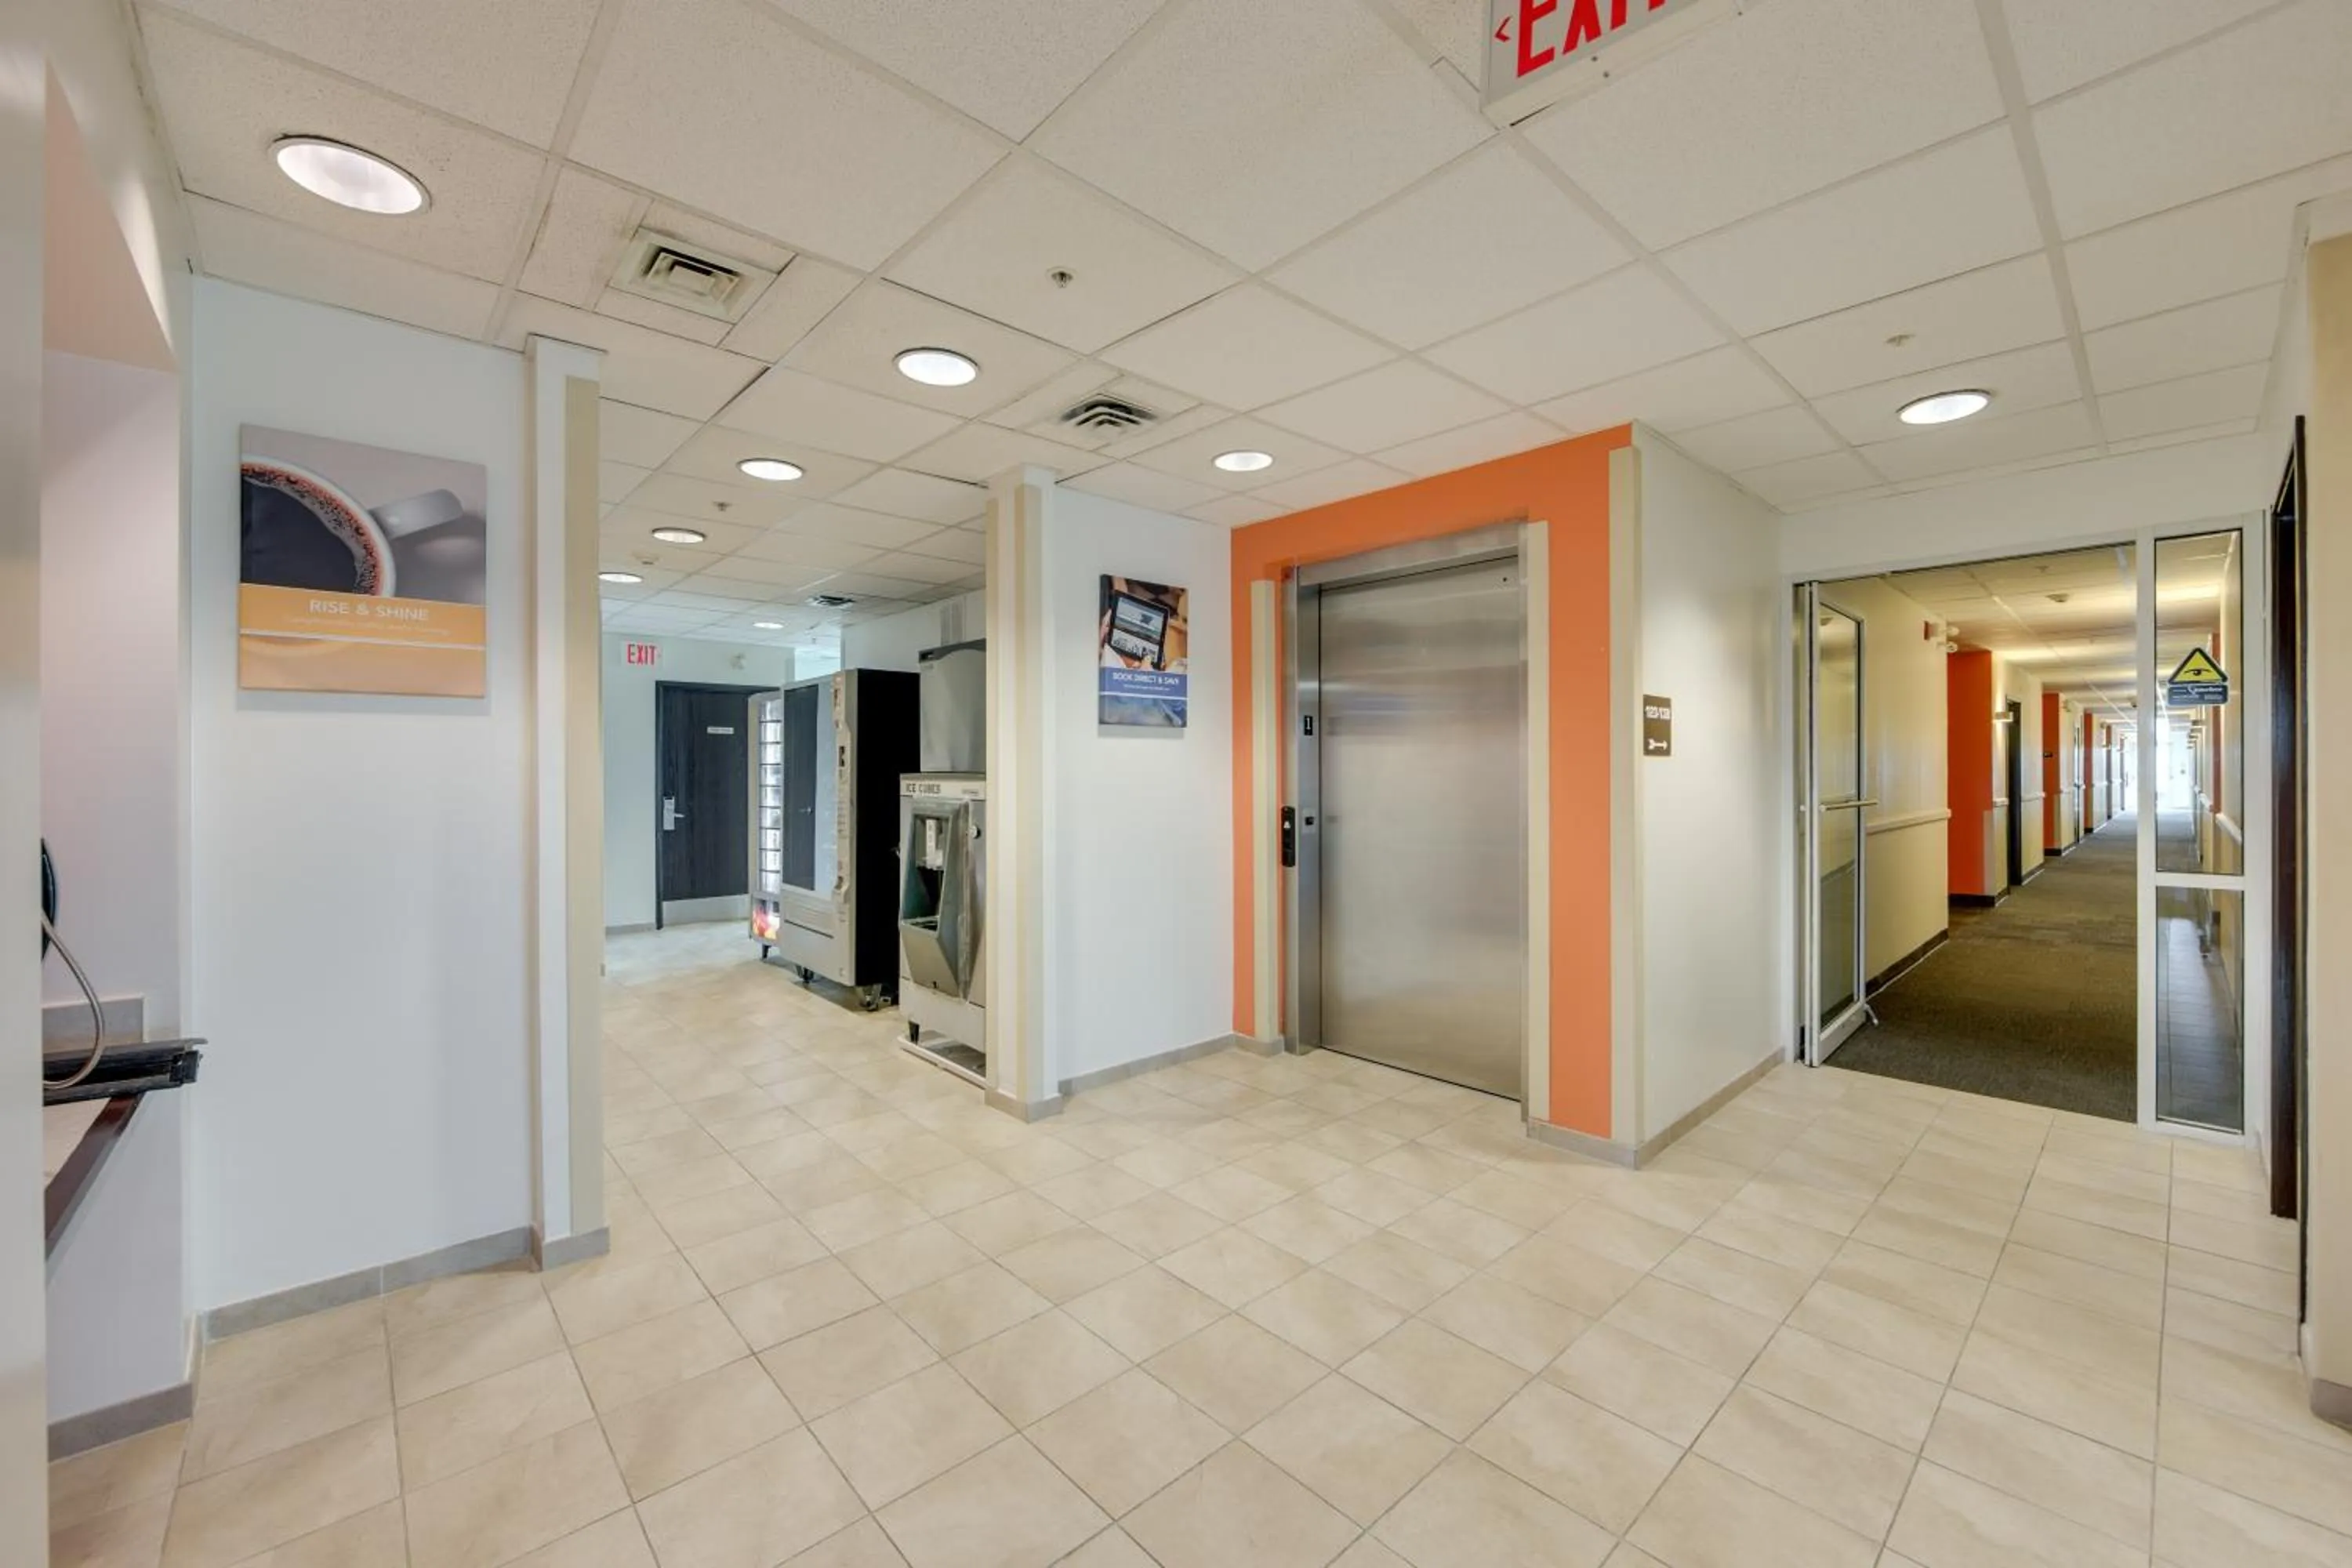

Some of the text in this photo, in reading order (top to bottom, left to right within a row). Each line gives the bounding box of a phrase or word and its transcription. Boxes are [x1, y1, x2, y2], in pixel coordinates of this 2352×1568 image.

[309, 600, 430, 621] RISE & SHINE
[627, 643, 657, 666] EXIT
[906, 782, 941, 793] ICE CUBES
